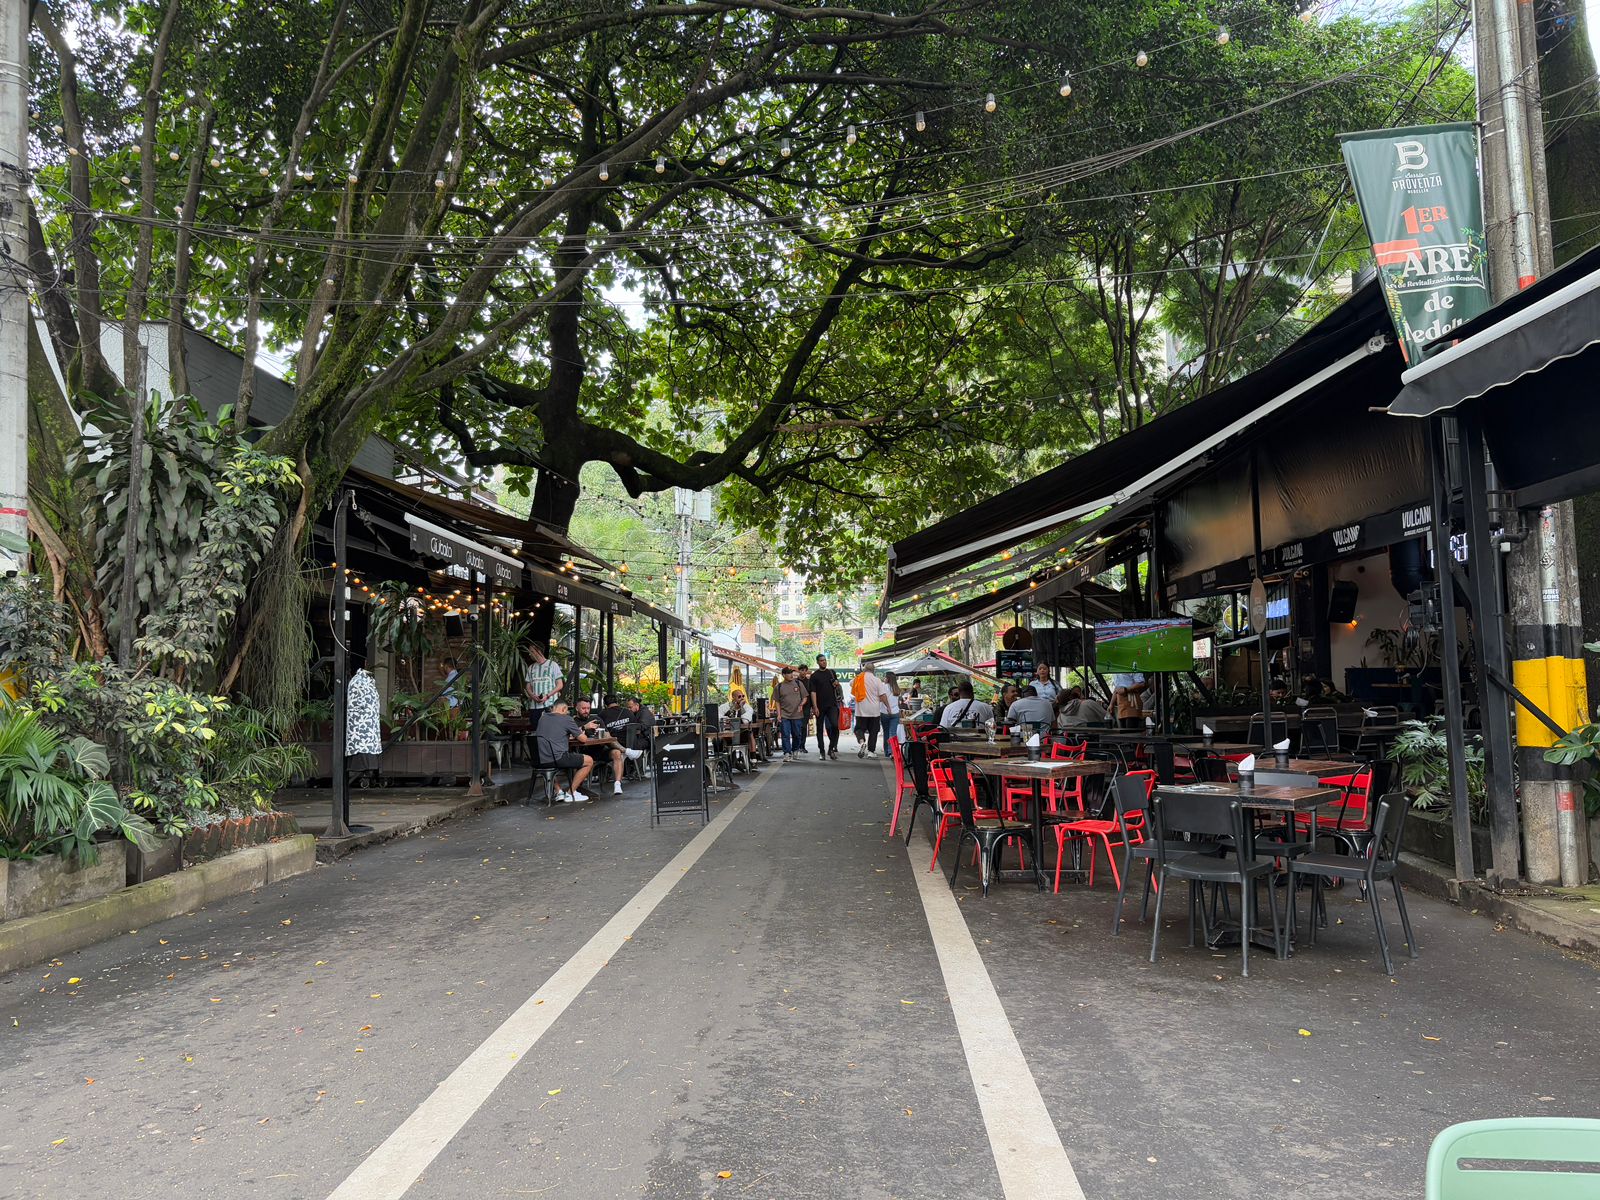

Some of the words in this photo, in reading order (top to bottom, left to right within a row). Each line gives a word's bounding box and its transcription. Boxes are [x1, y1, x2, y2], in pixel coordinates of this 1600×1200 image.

[1392, 176, 1443, 192] PROVENZA
[1402, 246, 1473, 278] ARE
[1424, 292, 1455, 313] de
